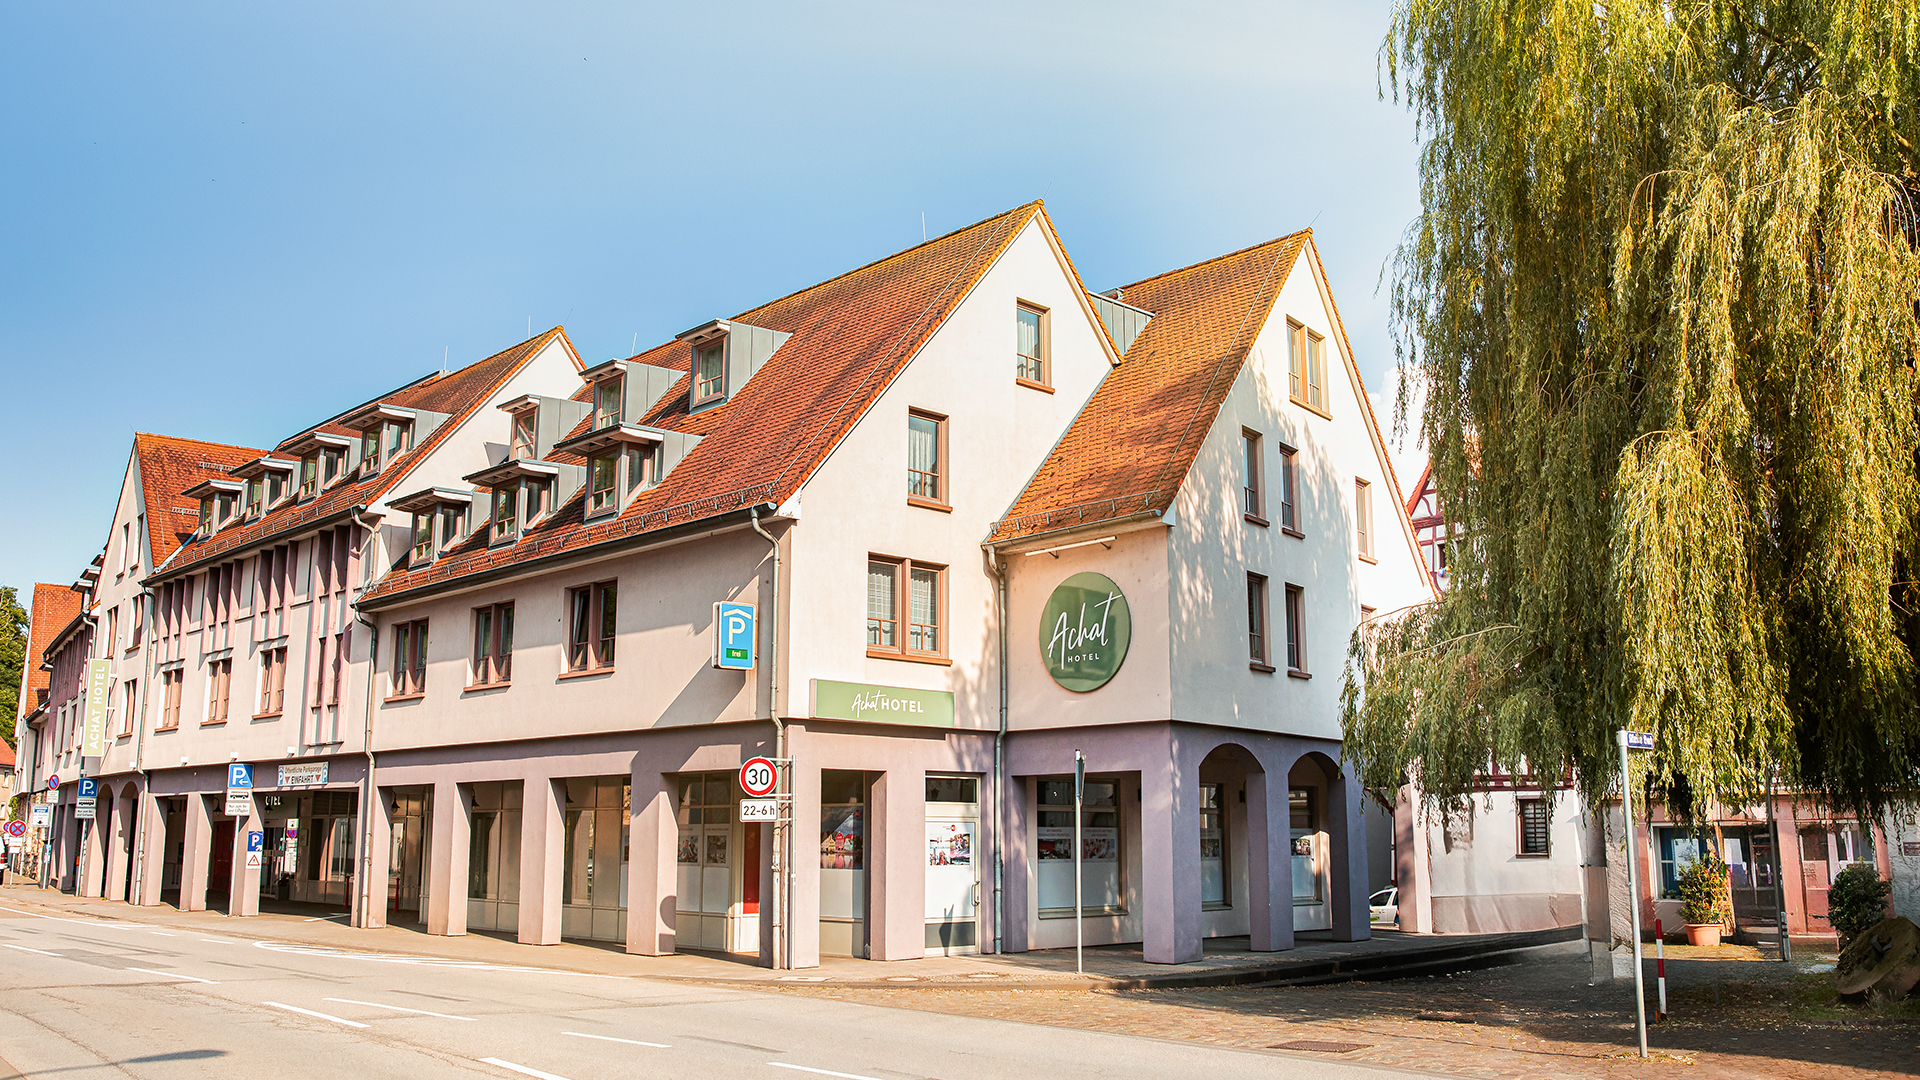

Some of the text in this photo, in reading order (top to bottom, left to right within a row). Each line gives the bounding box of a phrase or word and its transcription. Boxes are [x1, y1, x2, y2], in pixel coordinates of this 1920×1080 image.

[728, 616, 746, 645] P
[1047, 591, 1122, 670] Achat
[731, 649, 742, 658] frei
[1067, 652, 1100, 663] HOTEL
[89, 666, 105, 750] ACHAT HOTEL
[881, 697, 924, 714] HOTEL
[231, 767, 246, 785] P
[290, 774, 314, 784] EINFAHRT
[748, 768, 770, 786] 30
[82, 780, 94, 795] P
[251, 834, 260, 847] P
